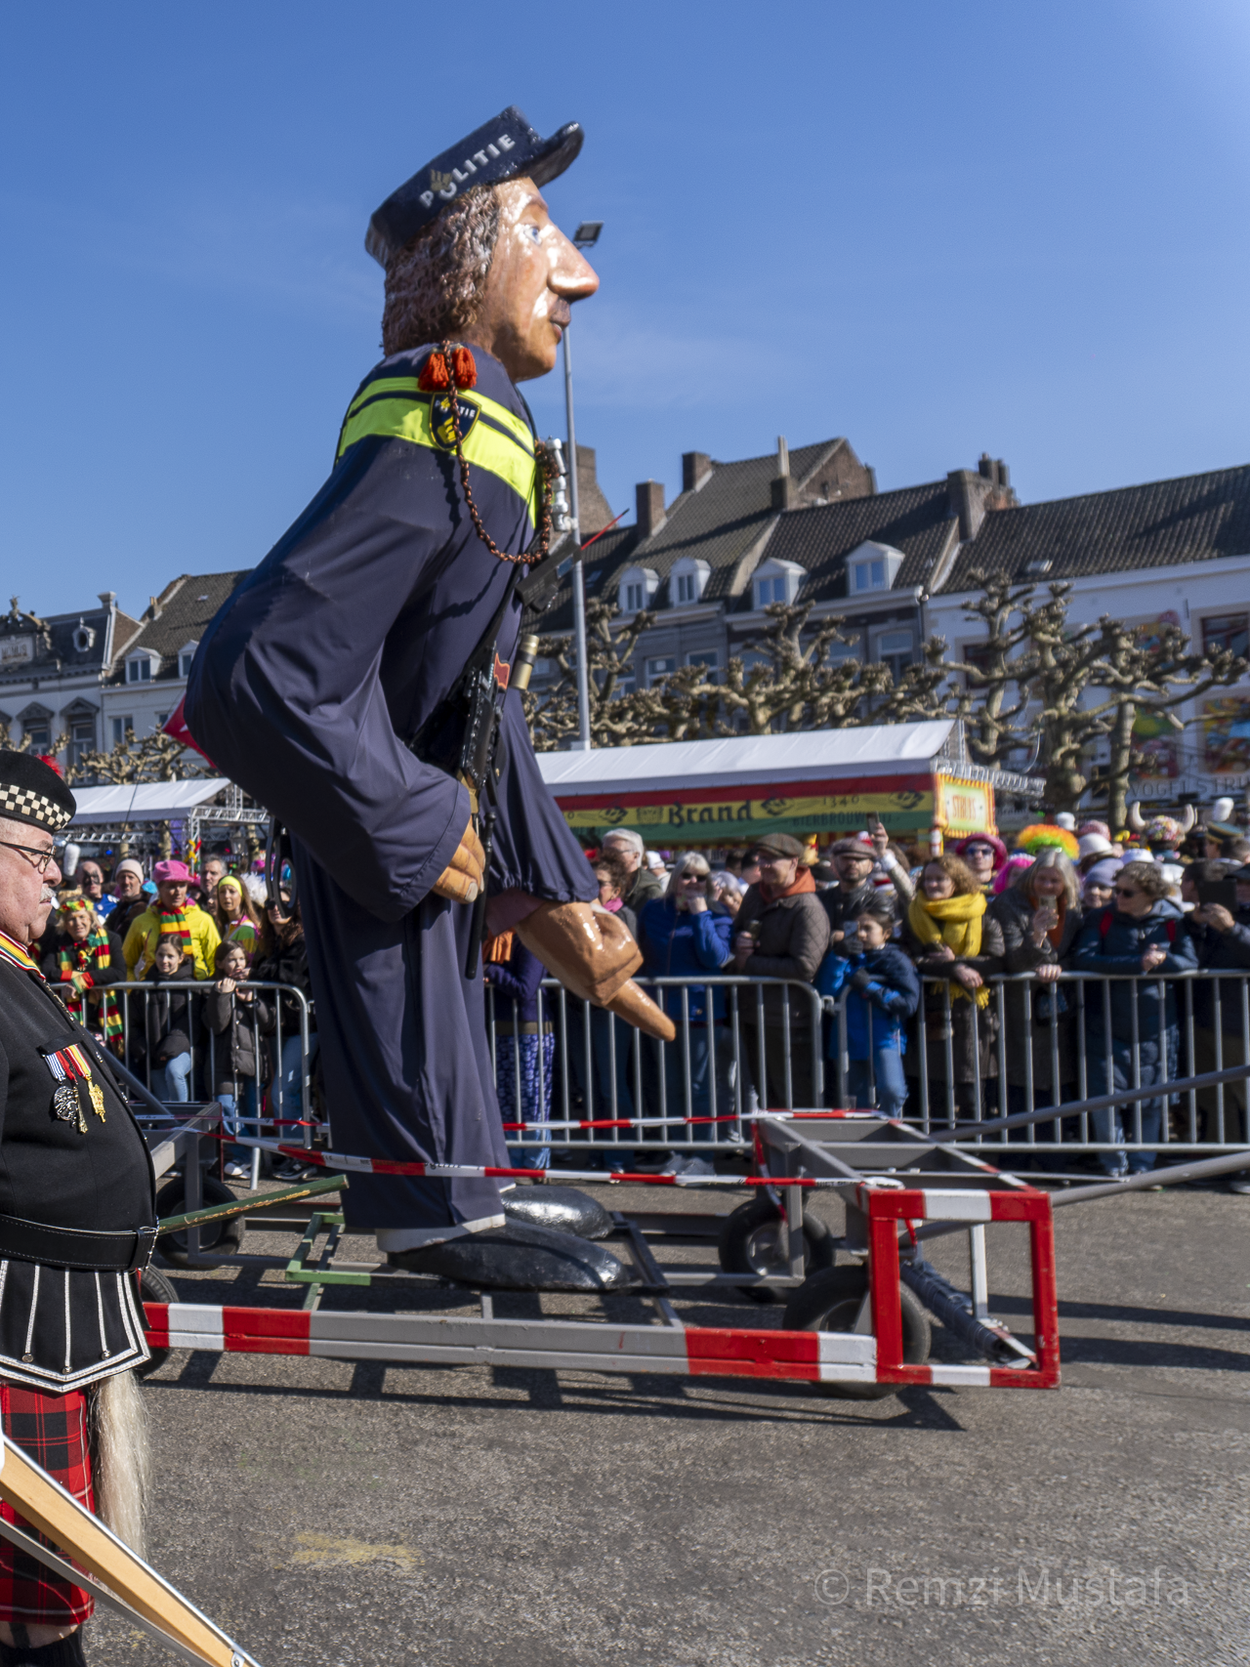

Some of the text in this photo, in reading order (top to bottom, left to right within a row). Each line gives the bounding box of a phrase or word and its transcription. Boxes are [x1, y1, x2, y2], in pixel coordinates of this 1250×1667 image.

[419, 133, 516, 209] POLITIE
[668, 800, 754, 828] Brand
[792, 811, 892, 827] BIERBROUWIJ
